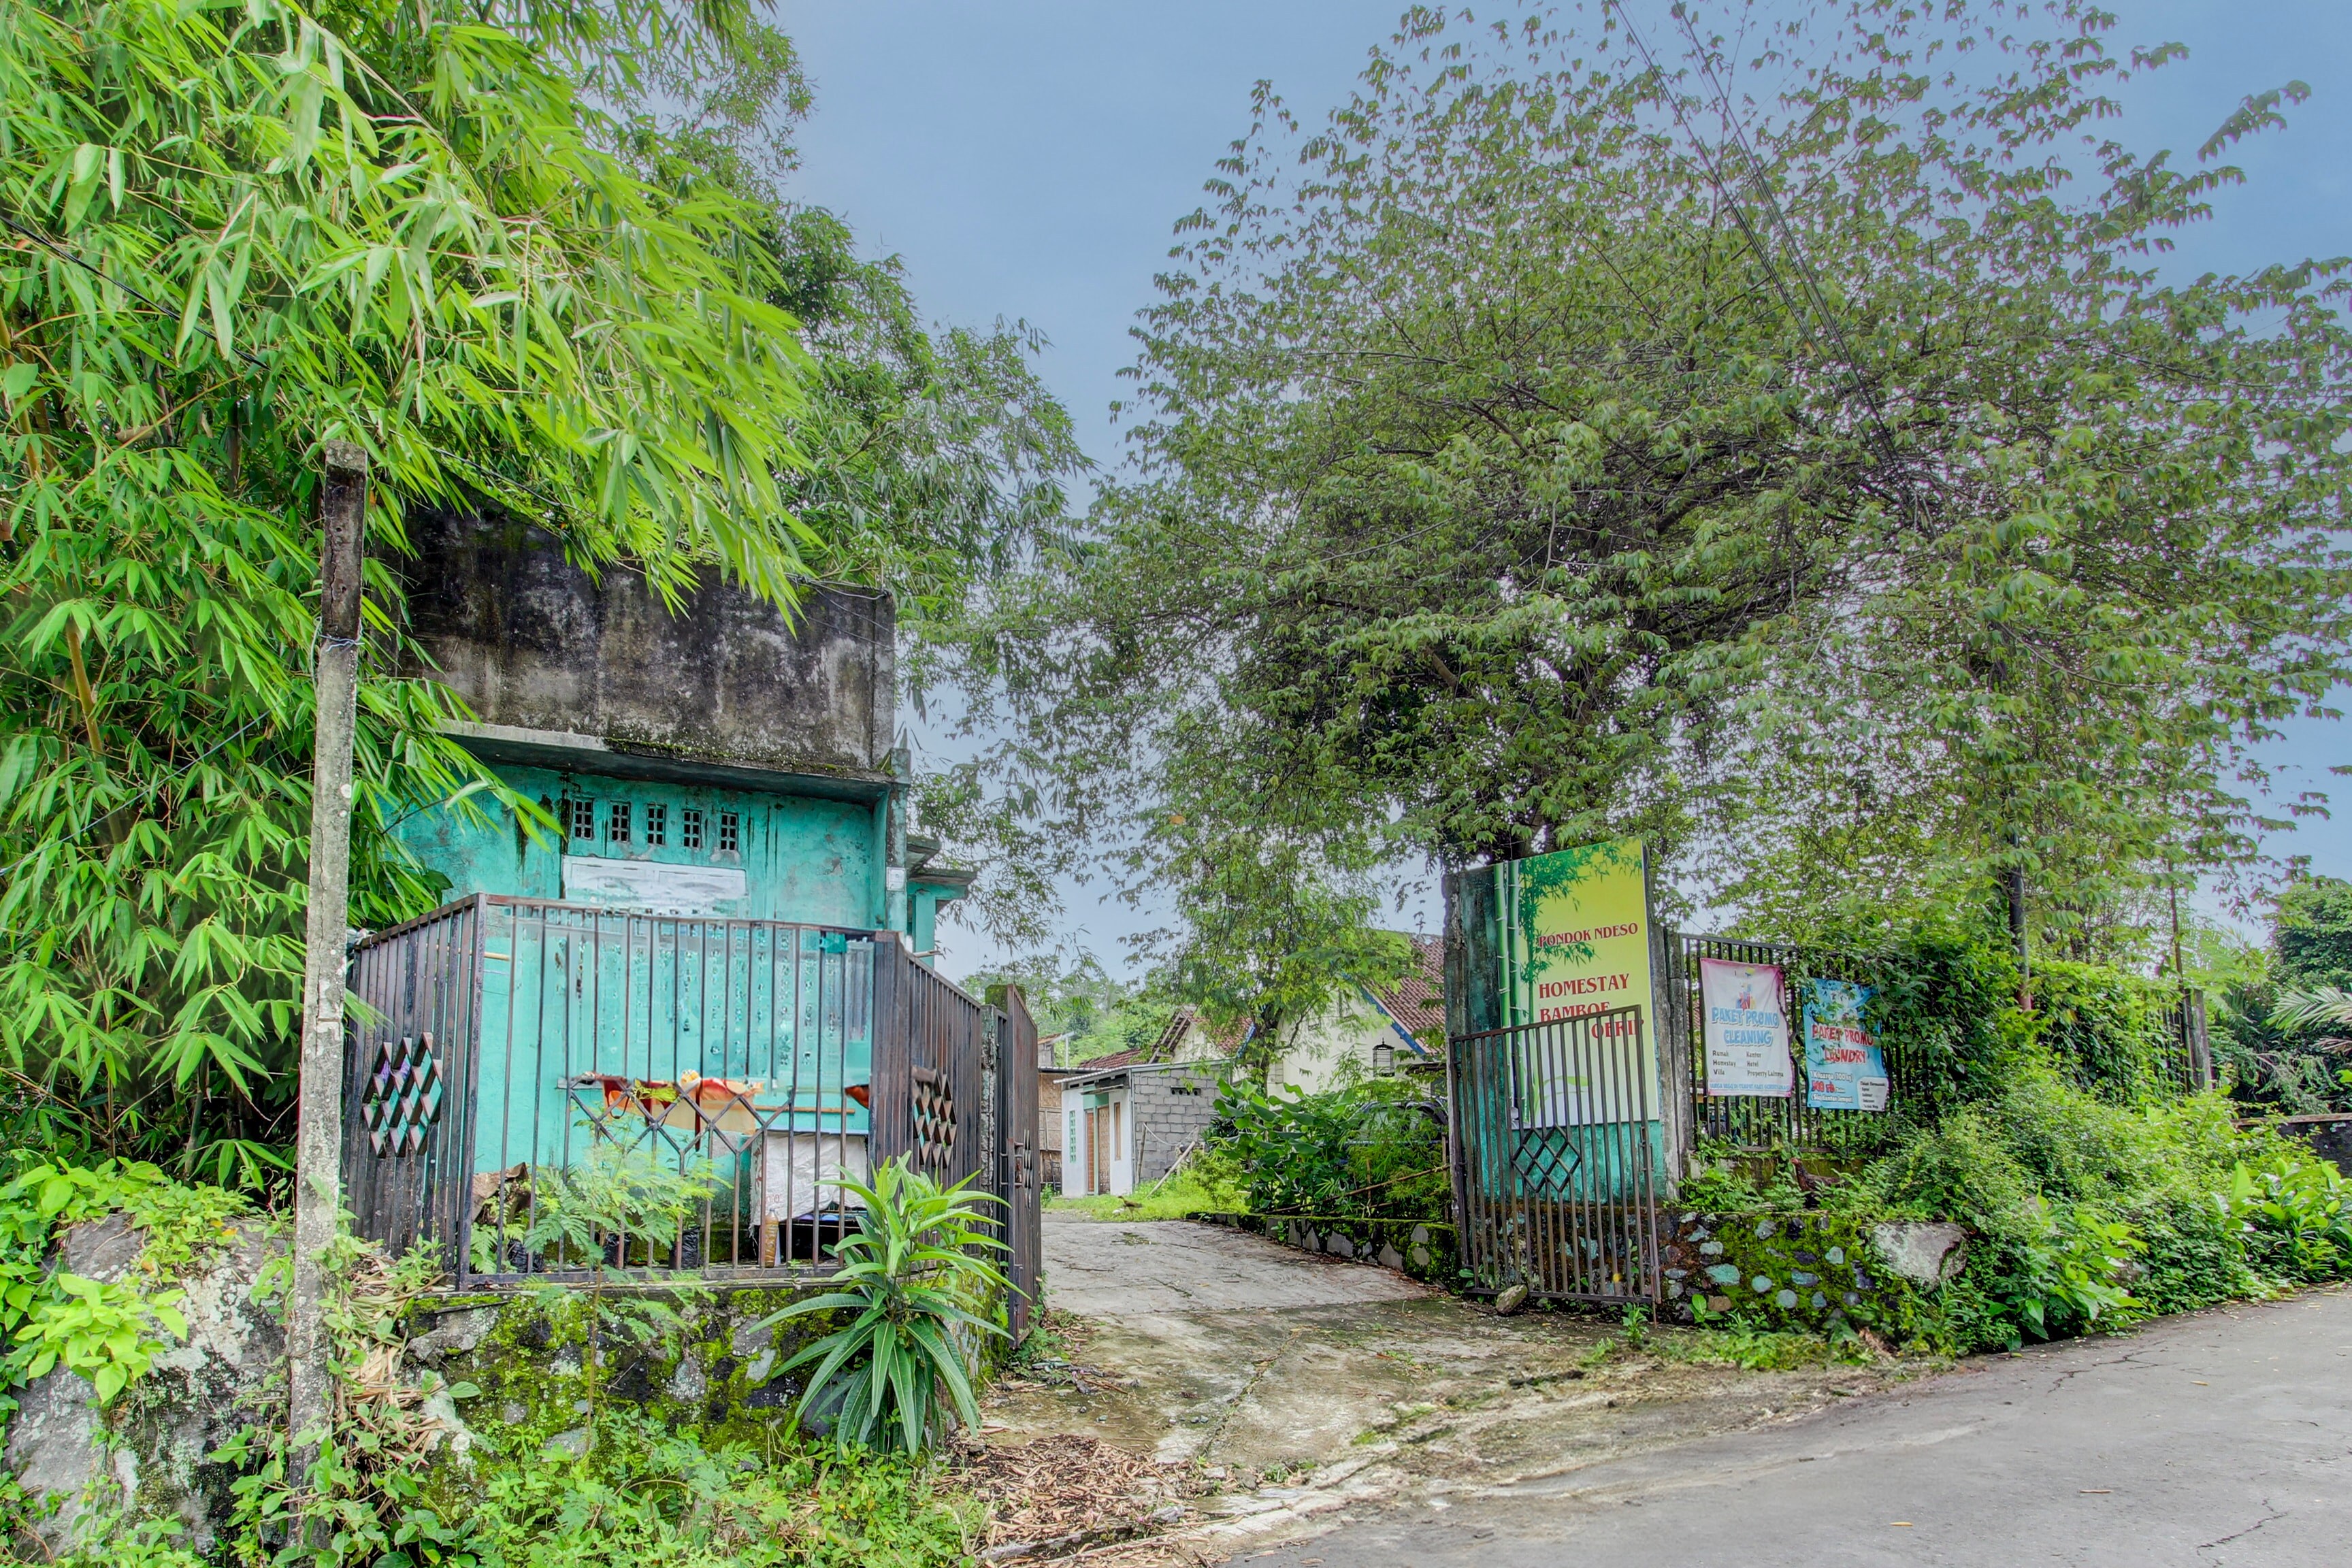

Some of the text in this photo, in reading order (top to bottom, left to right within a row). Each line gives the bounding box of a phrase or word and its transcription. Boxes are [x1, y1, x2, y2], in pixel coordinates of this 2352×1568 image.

[1539, 922, 1638, 947] PONDOK NDESO
[1539, 973, 1629, 998] HOMESTAY
[1712, 1007, 1780, 1028] PAKET PROMO
[1724, 1029, 1773, 1047] CLEANING
